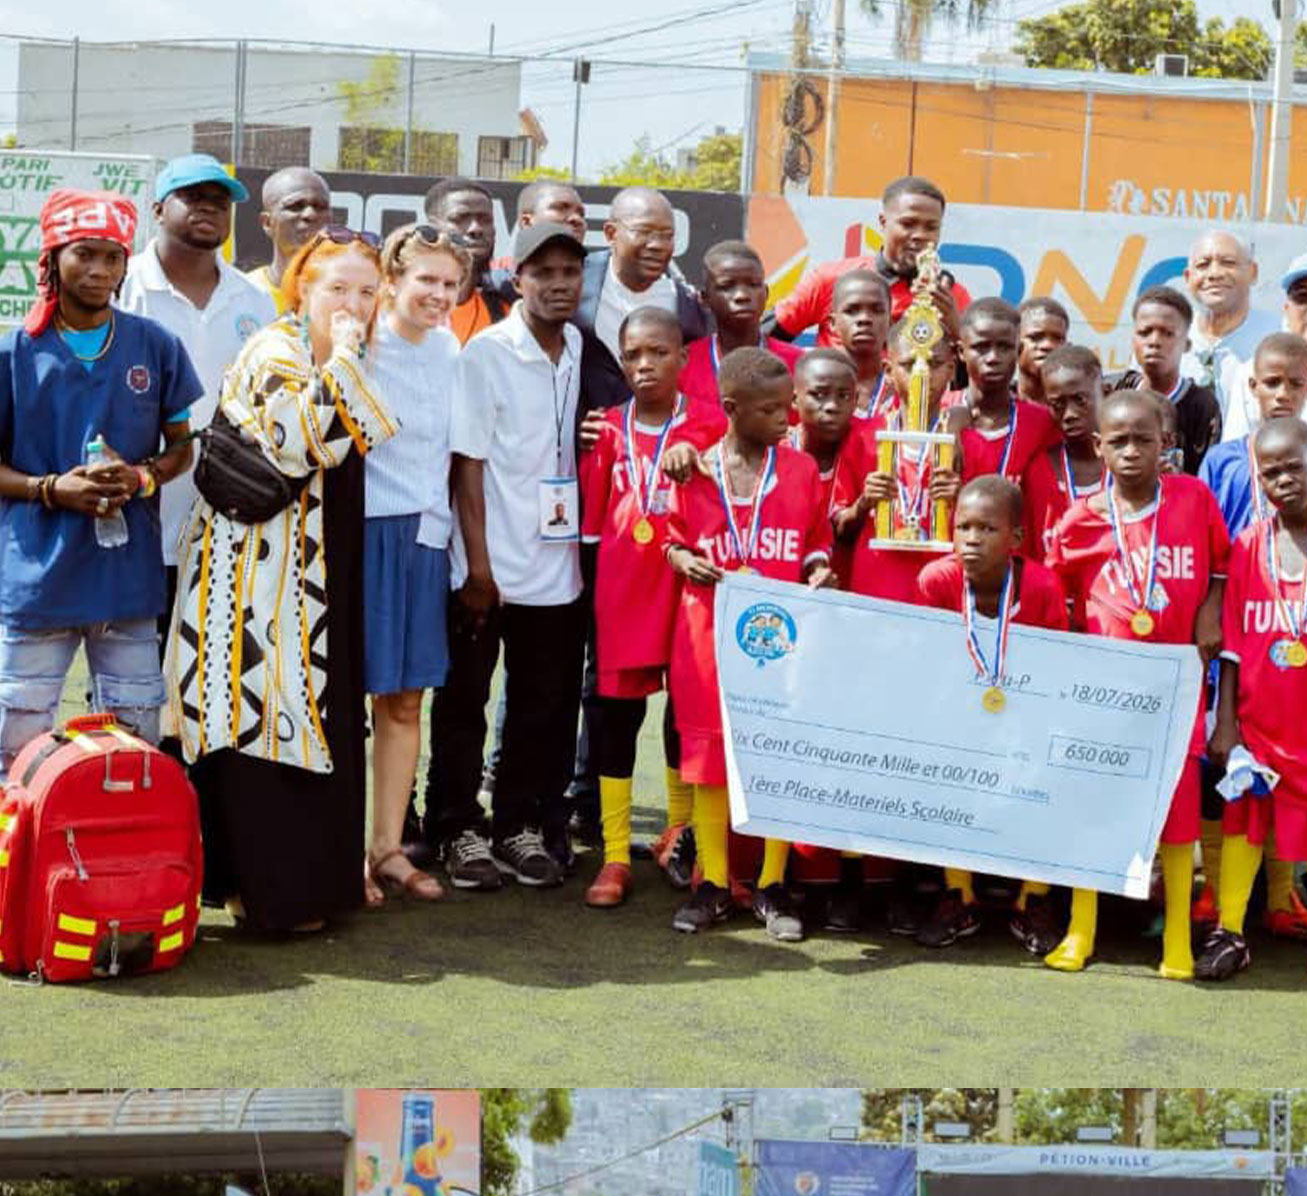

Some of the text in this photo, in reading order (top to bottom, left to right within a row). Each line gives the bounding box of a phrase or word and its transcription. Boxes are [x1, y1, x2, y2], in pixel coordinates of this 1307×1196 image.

[93, 162, 139, 177] JWE
[101, 178, 147, 195] VIT
[1150, 187, 1248, 223] SANTA
[1101, 545, 1195, 596] TUNSIE
[752, 732, 792, 753] Cent
[793, 738, 878, 770] Cinquante
[880, 754, 920, 776] Mille
[922, 765, 939, 779] et
[941, 763, 1000, 788] 00/100
[909, 799, 976, 827] Scolaire
